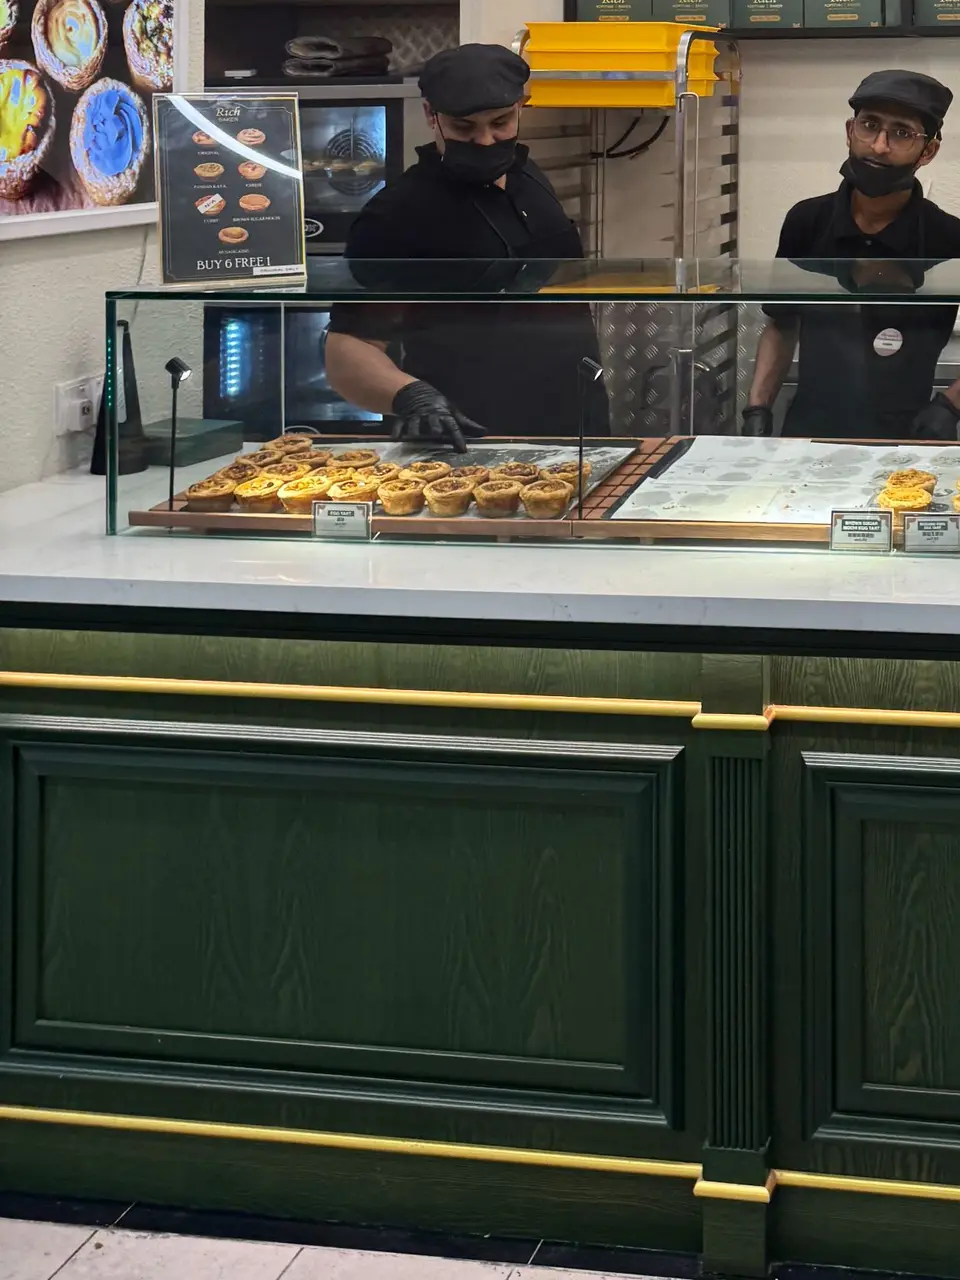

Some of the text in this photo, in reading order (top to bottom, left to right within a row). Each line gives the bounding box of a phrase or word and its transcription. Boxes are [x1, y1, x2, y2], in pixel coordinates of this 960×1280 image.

[216, 106, 241, 117] Rich
[197, 256, 271, 270] BUY 6 FREE 1
